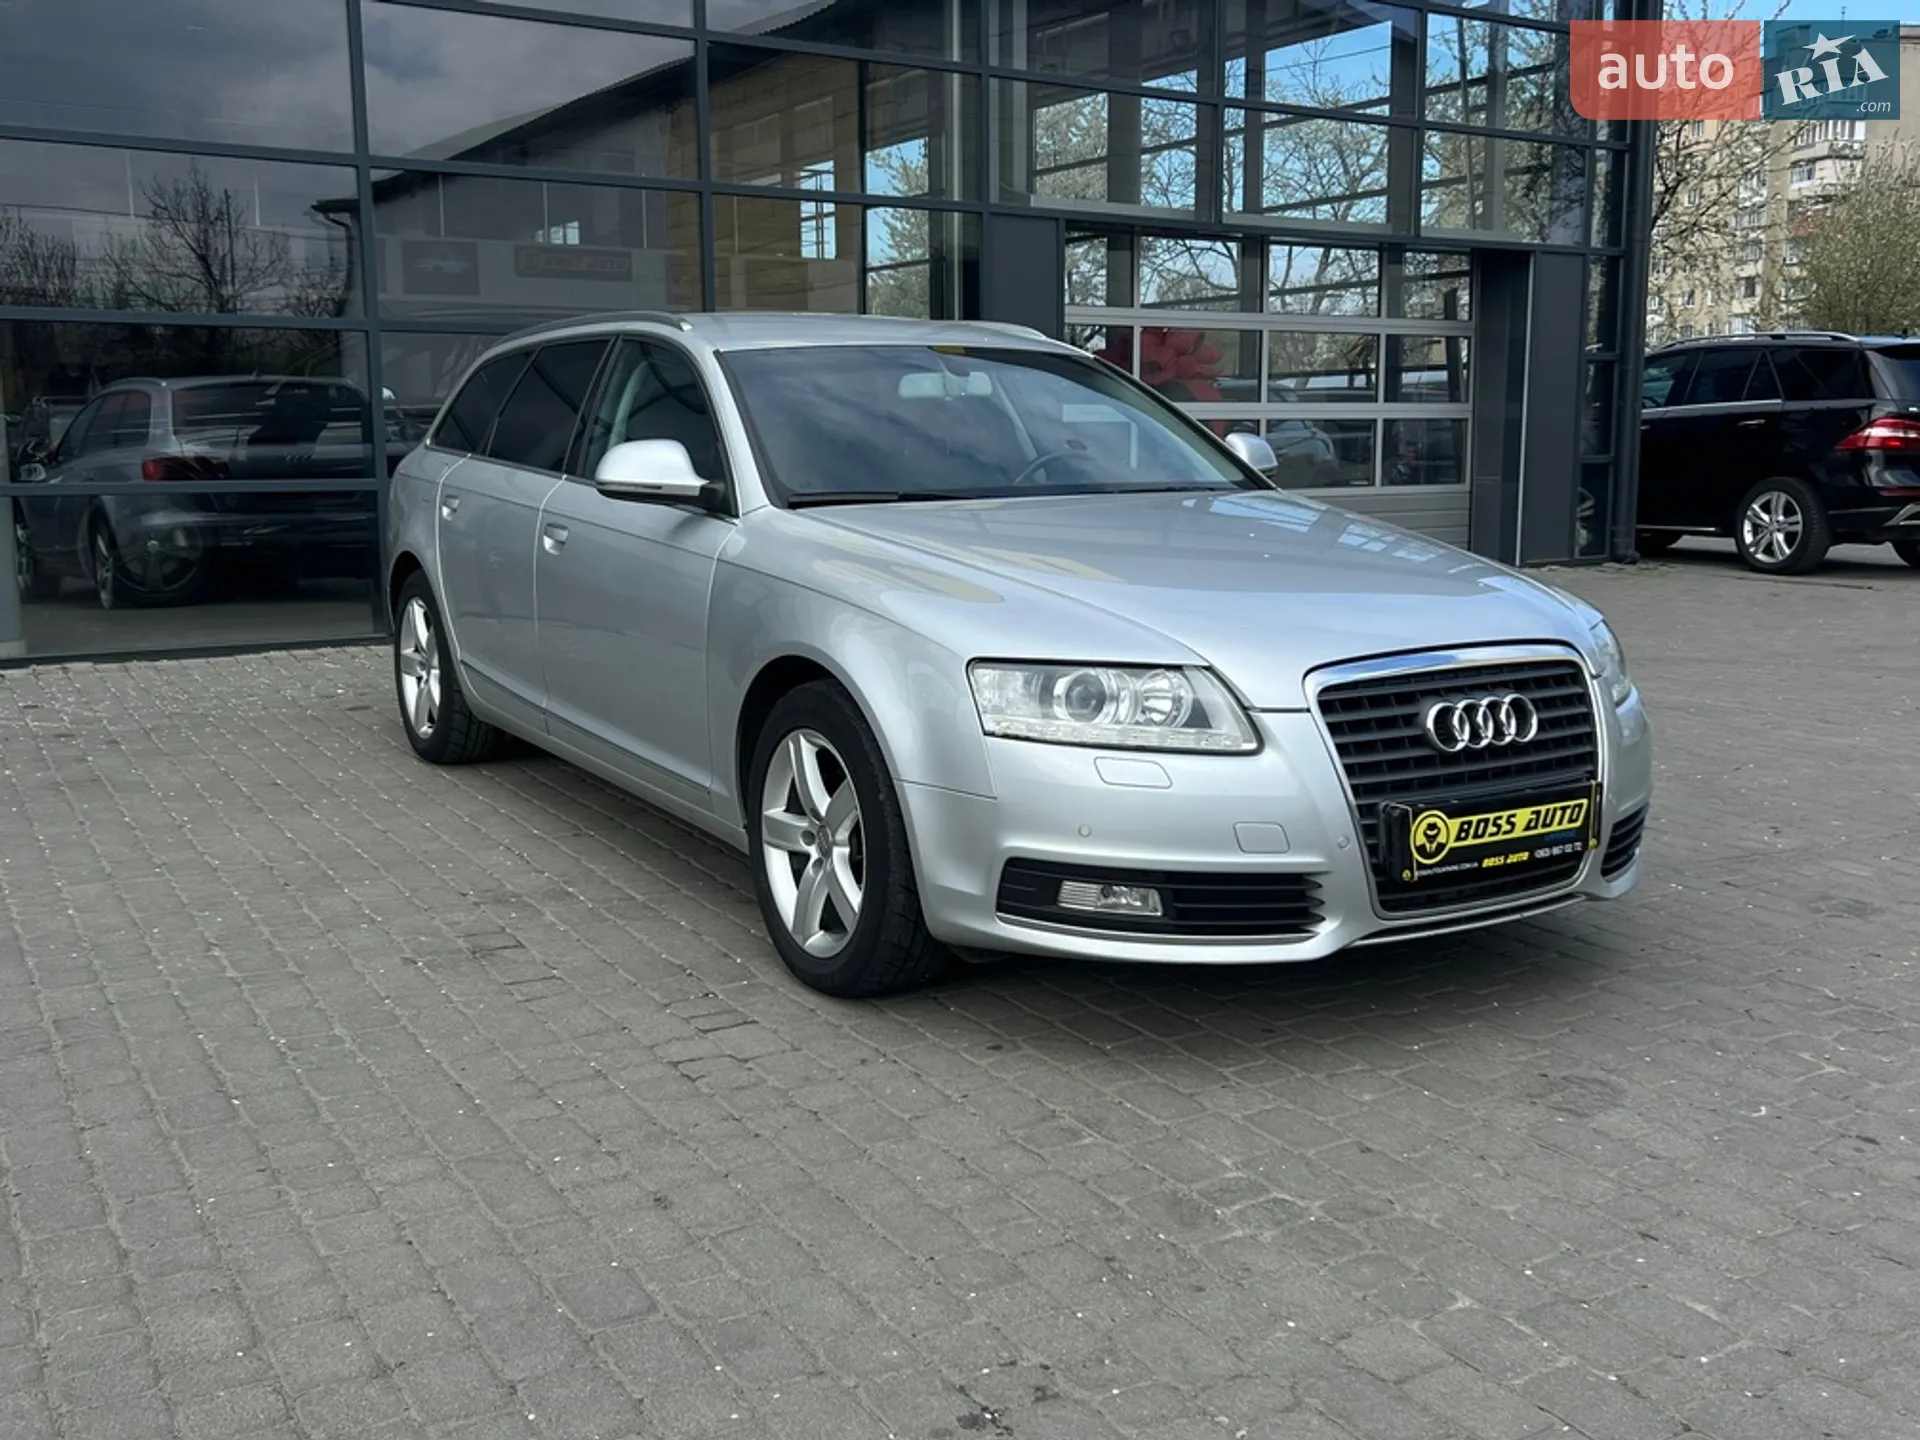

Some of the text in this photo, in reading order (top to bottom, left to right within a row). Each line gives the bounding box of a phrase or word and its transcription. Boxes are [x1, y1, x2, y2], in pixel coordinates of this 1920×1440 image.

[1455, 813, 1517, 842] BOSS
[1523, 803, 1584, 831] AUTO
[1482, 855, 1505, 867] BOSS
